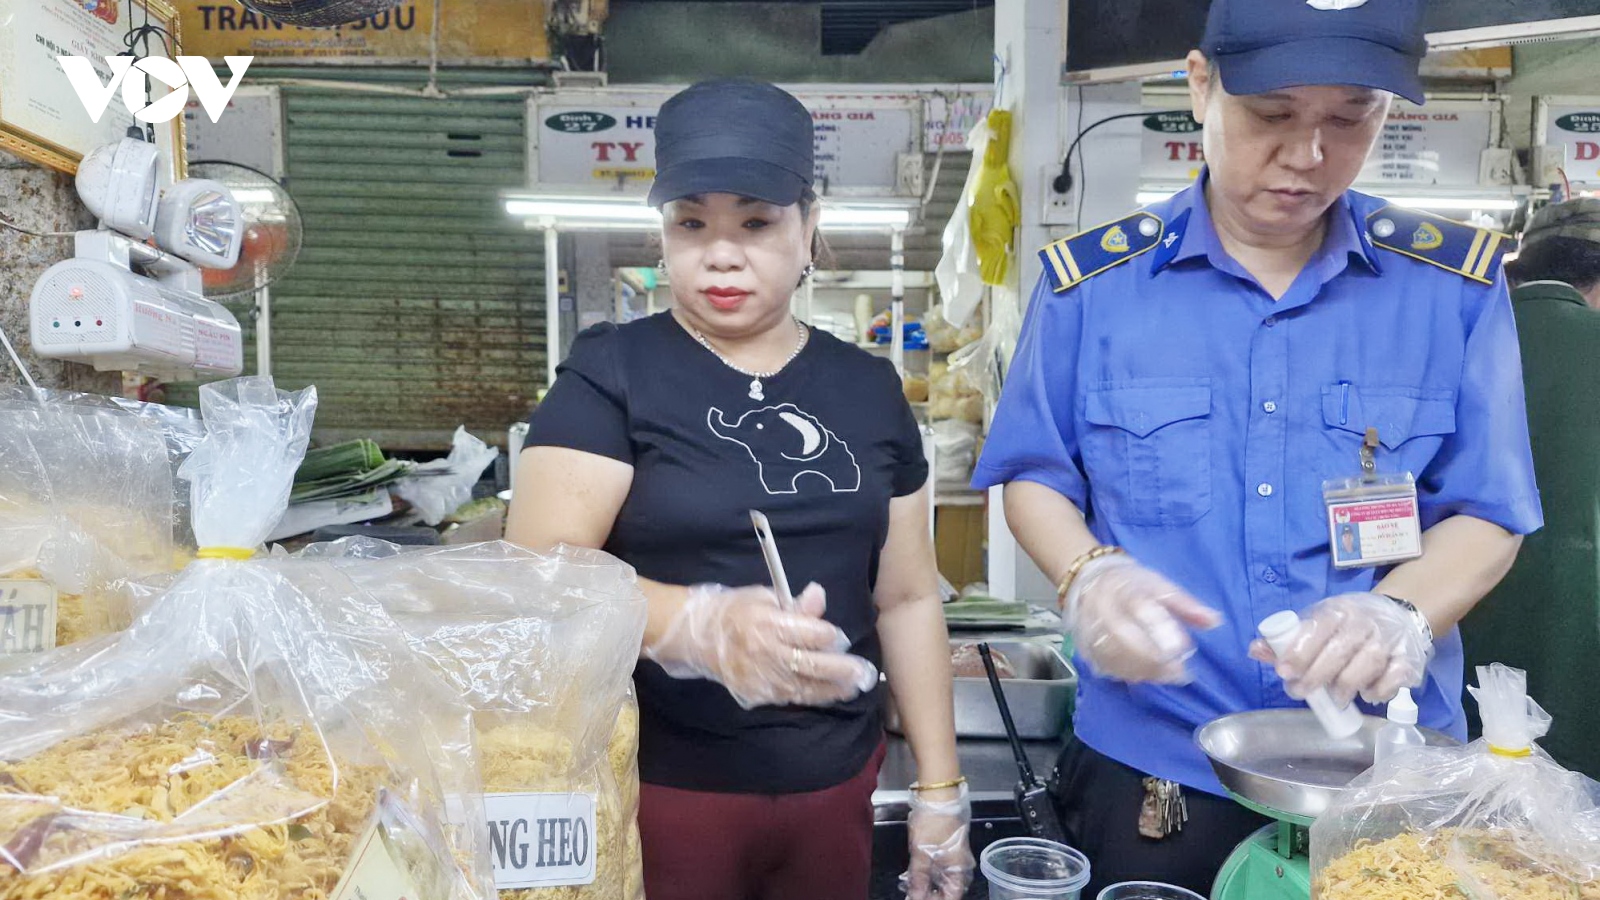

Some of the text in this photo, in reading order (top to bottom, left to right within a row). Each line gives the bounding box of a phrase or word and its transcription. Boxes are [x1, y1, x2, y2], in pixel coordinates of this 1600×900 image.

[564, 122, 597, 131] 27
[591, 142, 644, 161] TY
[1575, 142, 1600, 160] D
[536, 817, 588, 867] HEO
